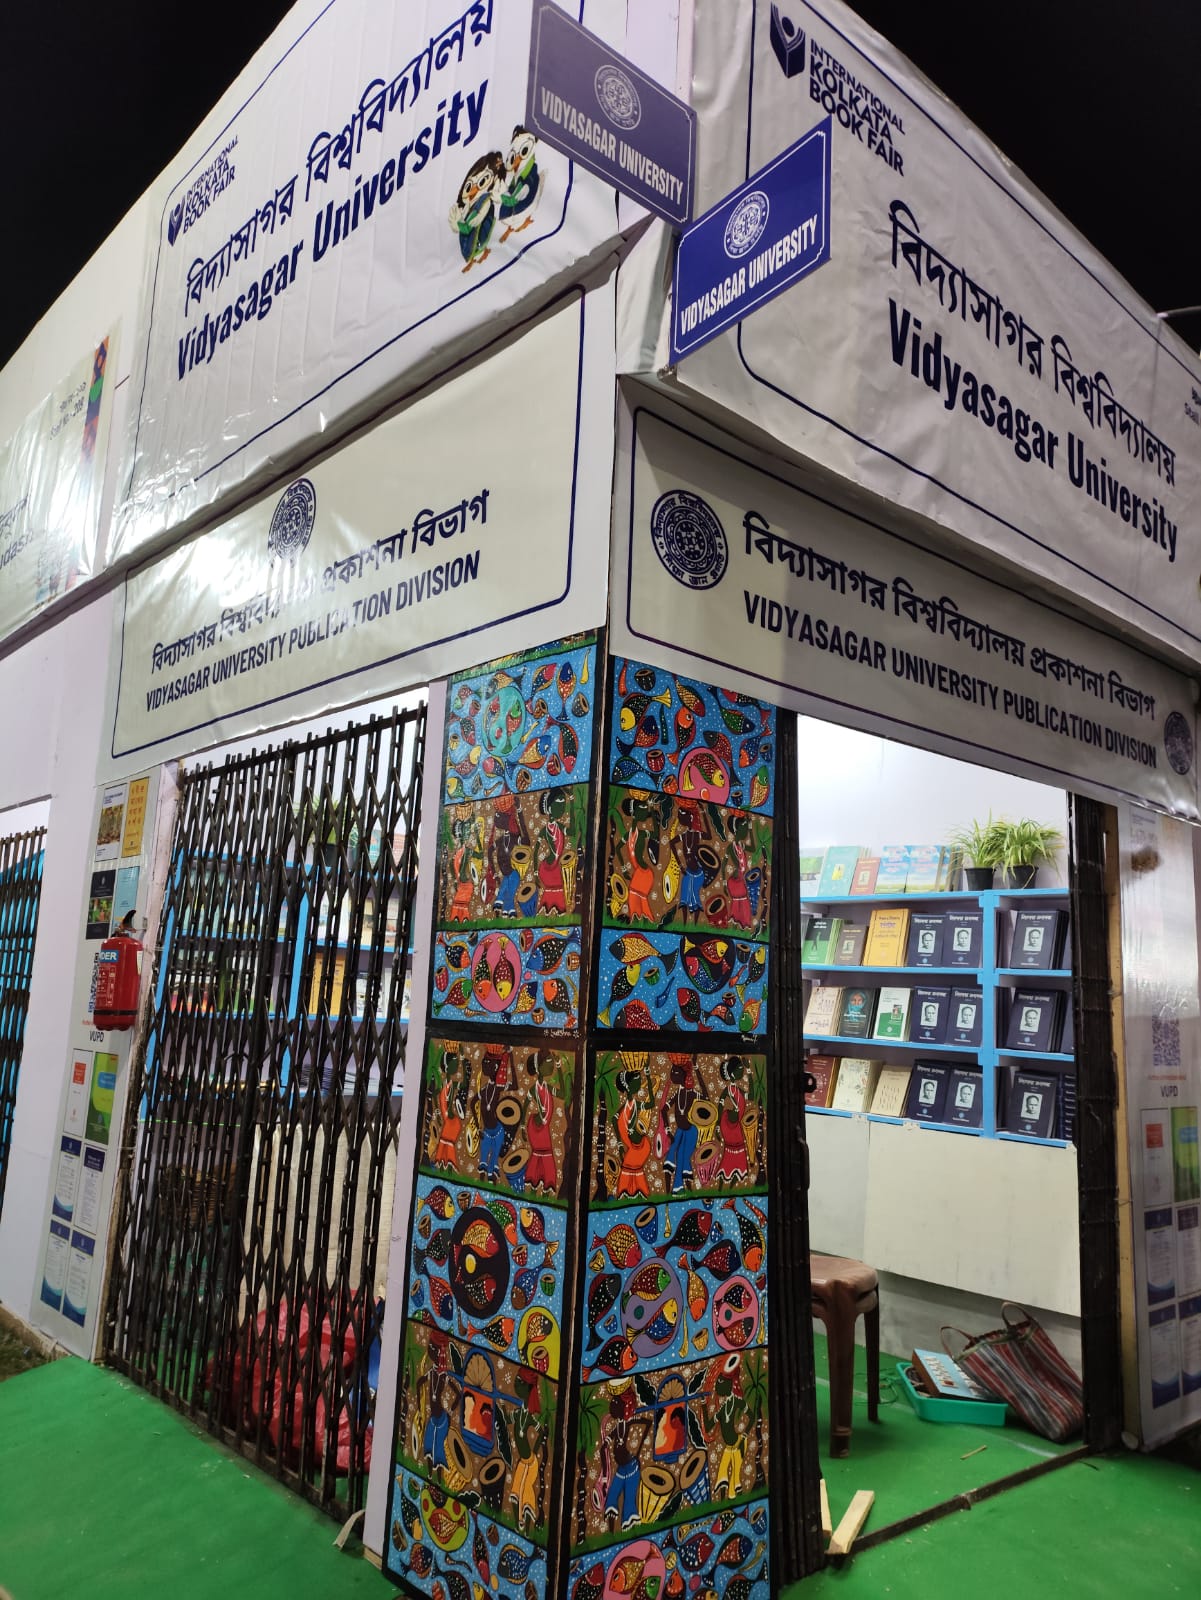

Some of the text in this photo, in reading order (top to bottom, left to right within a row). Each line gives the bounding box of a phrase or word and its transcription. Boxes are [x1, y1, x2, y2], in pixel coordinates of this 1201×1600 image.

[542, 86, 617, 161] VIDYASAGAR
[618, 138, 684, 204] UNIVERSITY
[810, 54, 893, 145] KOLKATA
[810, 77, 904, 176] BOOK FAIR
[811, 38, 905, 135] INTERNATIONAL
[178, 241, 302, 380] Vidyasagar
[313, 80, 489, 262] University
[183, 165, 235, 234] BOOK FAIR
[185, 0, 493, 317] বিদ্যাসাগর বিশ্ববিদ্যালয়
[185, 158, 229, 216] KOLKATA
[187, 136, 238, 200] INTERNATIONAL
[681, 278, 746, 336] VIDYASAGAR
[748, 214, 817, 291] UNIVERSITY
[888, 200, 1044, 381] বিদ্যাসাগর
[1051, 336, 1176, 487] বিশ্ববিদ্যালয়
[889, 299, 1178, 562] Vidyasagar University
[146, 549, 481, 713] VIDYASAGAR UNIVERSITY PUBLICATION DIVISION
[152, 622, 218, 674] বিদ্যাসাগর
[411, 488, 489, 555] বিভাগ
[743, 510, 1155, 720] বিদ্যাসাগর বিশ্ববিদ্যালয় প্রকাশনা বিভাগ
[743, 590, 887, 671] VIDYASAGAR
[892, 648, 999, 711] UNIVERSITY
[1003, 690, 1102, 748] PUBLICATION
[1105, 727, 1157, 769] DIVISION
